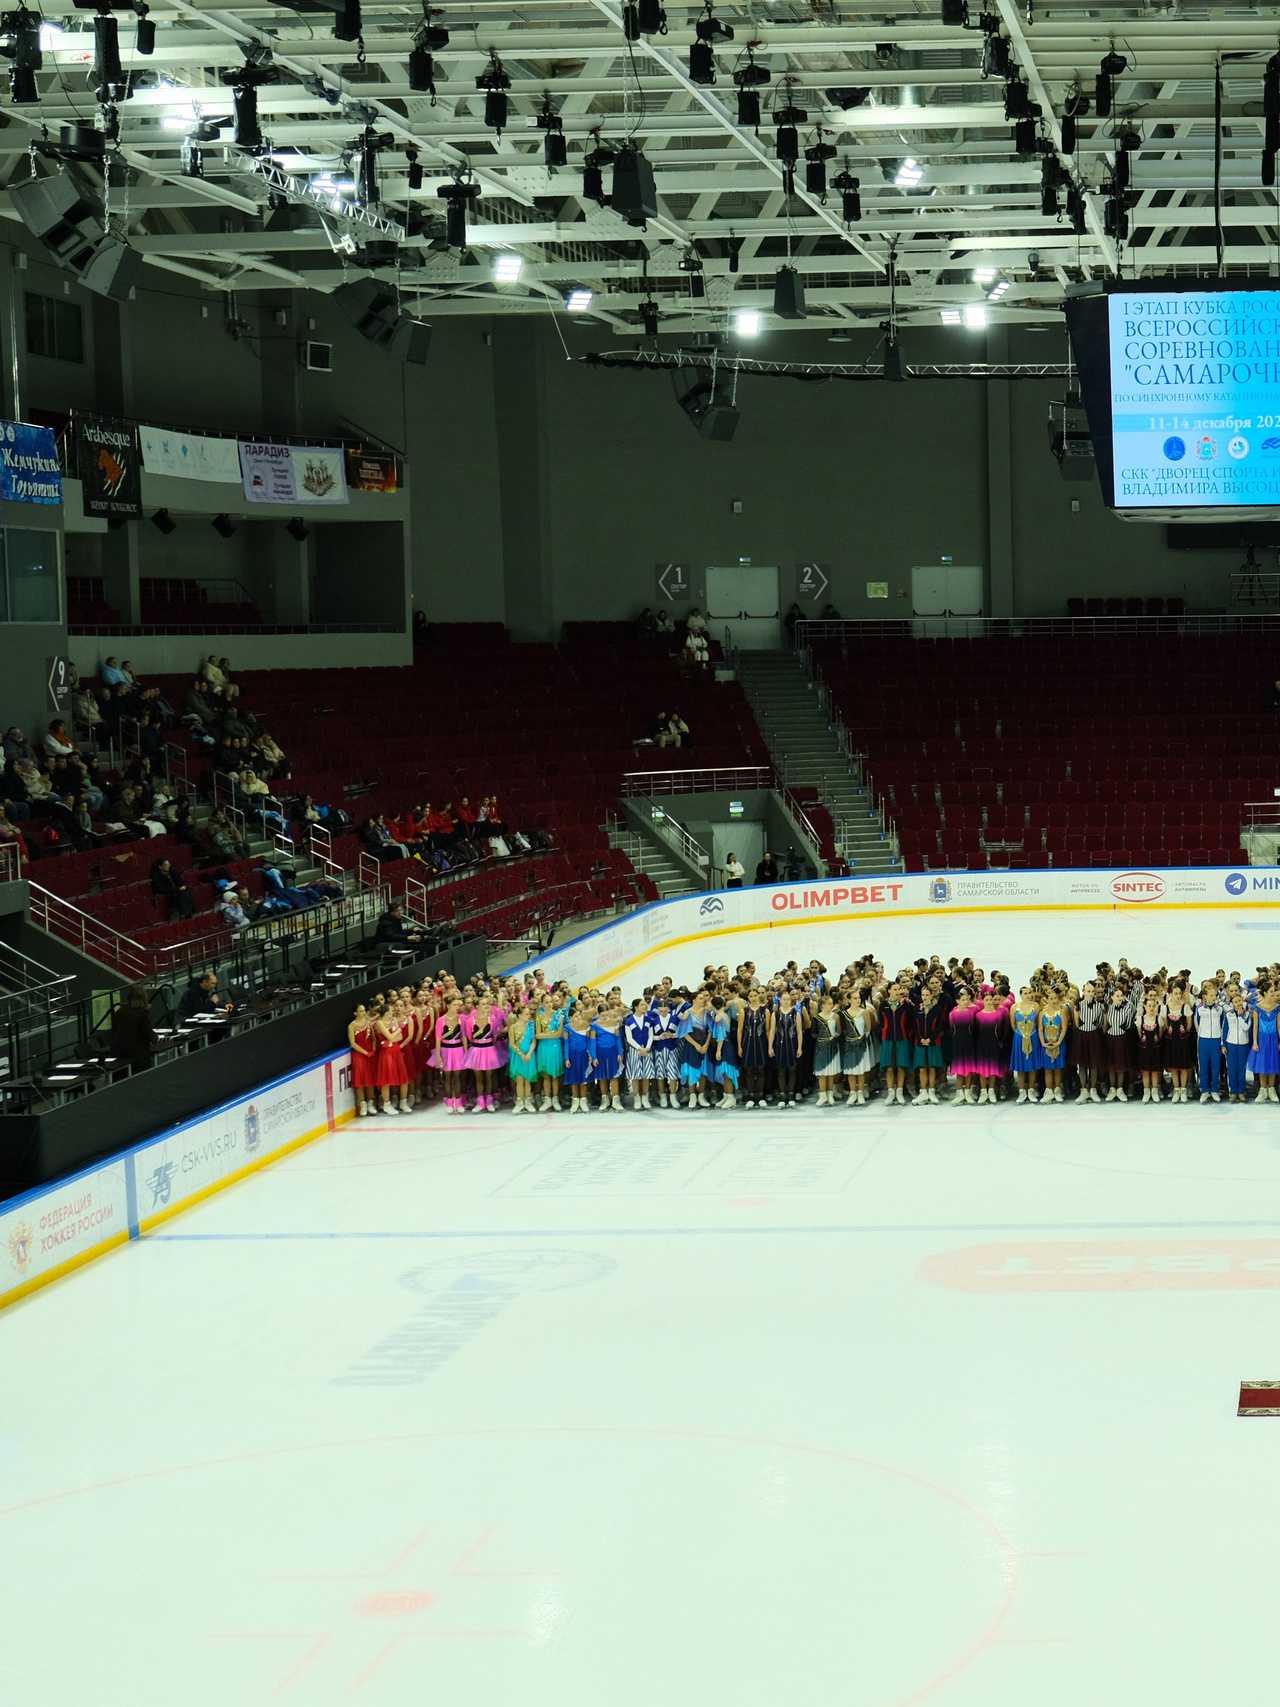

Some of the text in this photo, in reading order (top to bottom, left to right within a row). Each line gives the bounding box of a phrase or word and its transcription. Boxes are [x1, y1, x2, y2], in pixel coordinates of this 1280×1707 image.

[1133, 301, 1179, 316] ЭТАП
[1184, 300, 1238, 315] КУБКА
[1114, 394, 1131, 403] ПО
[1131, 393, 1212, 403] СИНХРОННОМУ
[1213, 392, 1264, 402] КАТАНИЮ
[1265, 391, 1280, 401] НА
[82, 423, 131, 449] Arabesque
[1149, 415, 1190, 430] 11-14
[1192, 414, 1252, 433] декабря
[245, 444, 290, 459] ПАРАДИЗ
[1121, 468, 1149, 481] СКК
[1151, 466, 1210, 481] "ДВОРЕЦ
[1212, 466, 1267, 480] СПОРТА
[1122, 482, 1220, 497] ВЛАДИМИРА
[675, 566, 682, 583] 1
[802, 566, 813, 583] 2
[58, 660, 65, 685] 9
[771, 883, 904, 911] OLIMPBET
[957, 881, 1019, 889] ПРАВИТЕЛЬСТВО
[957, 887, 1040, 897] САМАРСКОЙ ОБЛАСТИ
[1112, 882, 1163, 893] SINTEC
[262, 1091, 303, 1120] ПРАВИТЕЛЬСТВО
[263, 1099, 316, 1135] САМАРСКОЙ ОБЛАСТИ
[181, 1132, 238, 1173] CSK-VVS.RU
[531, 1138, 623, 1190] КОСТЮМОВ
[577, 1140, 657, 1187] МУЖСКИХ
[622, 1141, 697, 1184] МАГАЗИН
[716, 1135, 812, 1188] LEAGUE
[779, 1134, 851, 1188] GENTLEMEN
[39, 1193, 92, 1231] ФЕДЕРАЦИЯ
[40, 1202, 114, 1255] ХОККЕЯ РОССИИ
